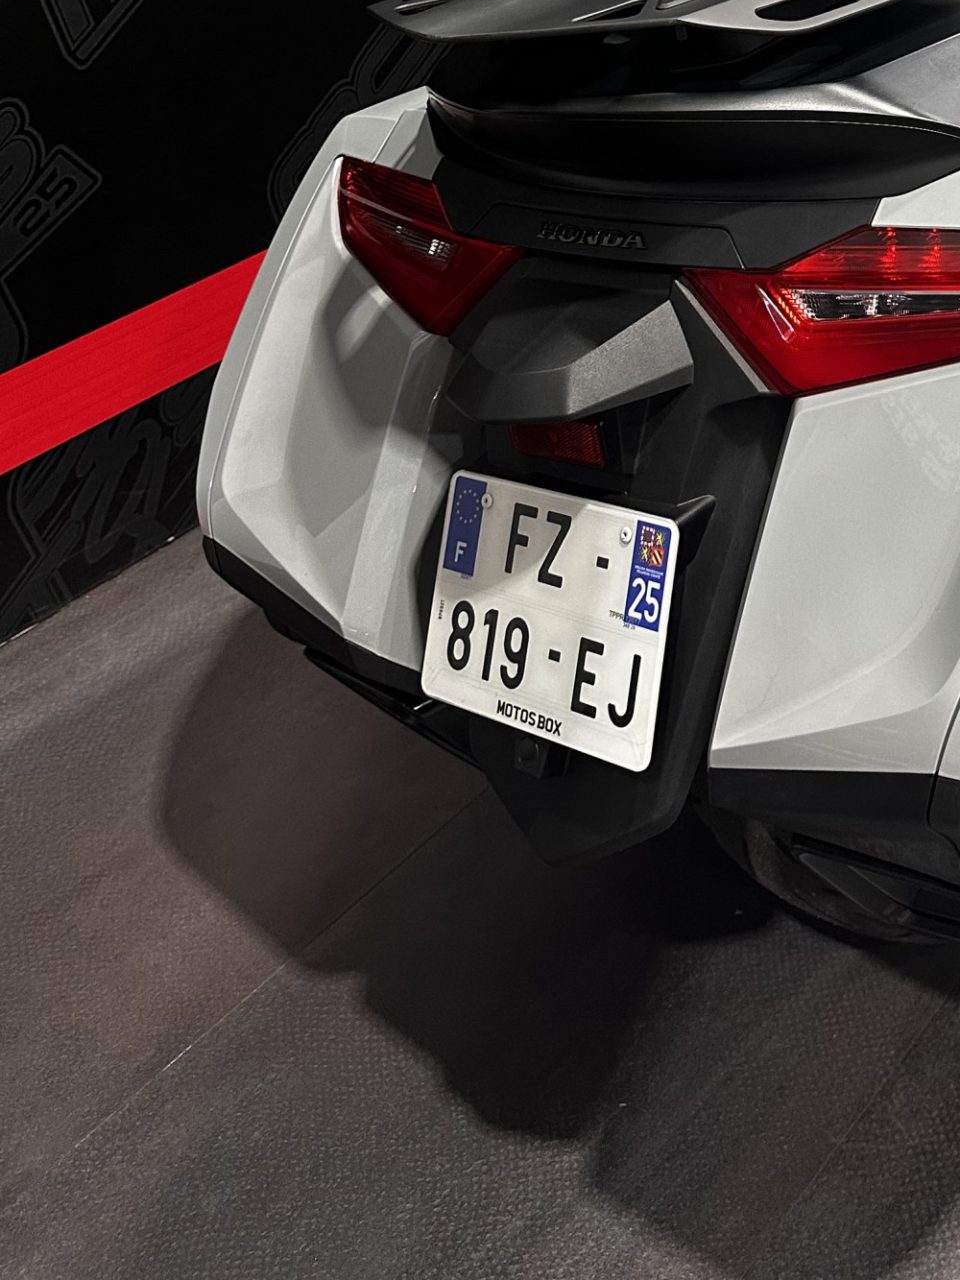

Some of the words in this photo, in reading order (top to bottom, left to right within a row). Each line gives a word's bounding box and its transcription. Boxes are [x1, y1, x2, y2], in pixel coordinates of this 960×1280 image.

[536, 222, 648, 250] HONDA
[455, 540, 468, 562] F
[628, 577, 661, 623] 25
[496, 699, 537, 726] MOTOS
[536, 714, 562, 736] BOX
